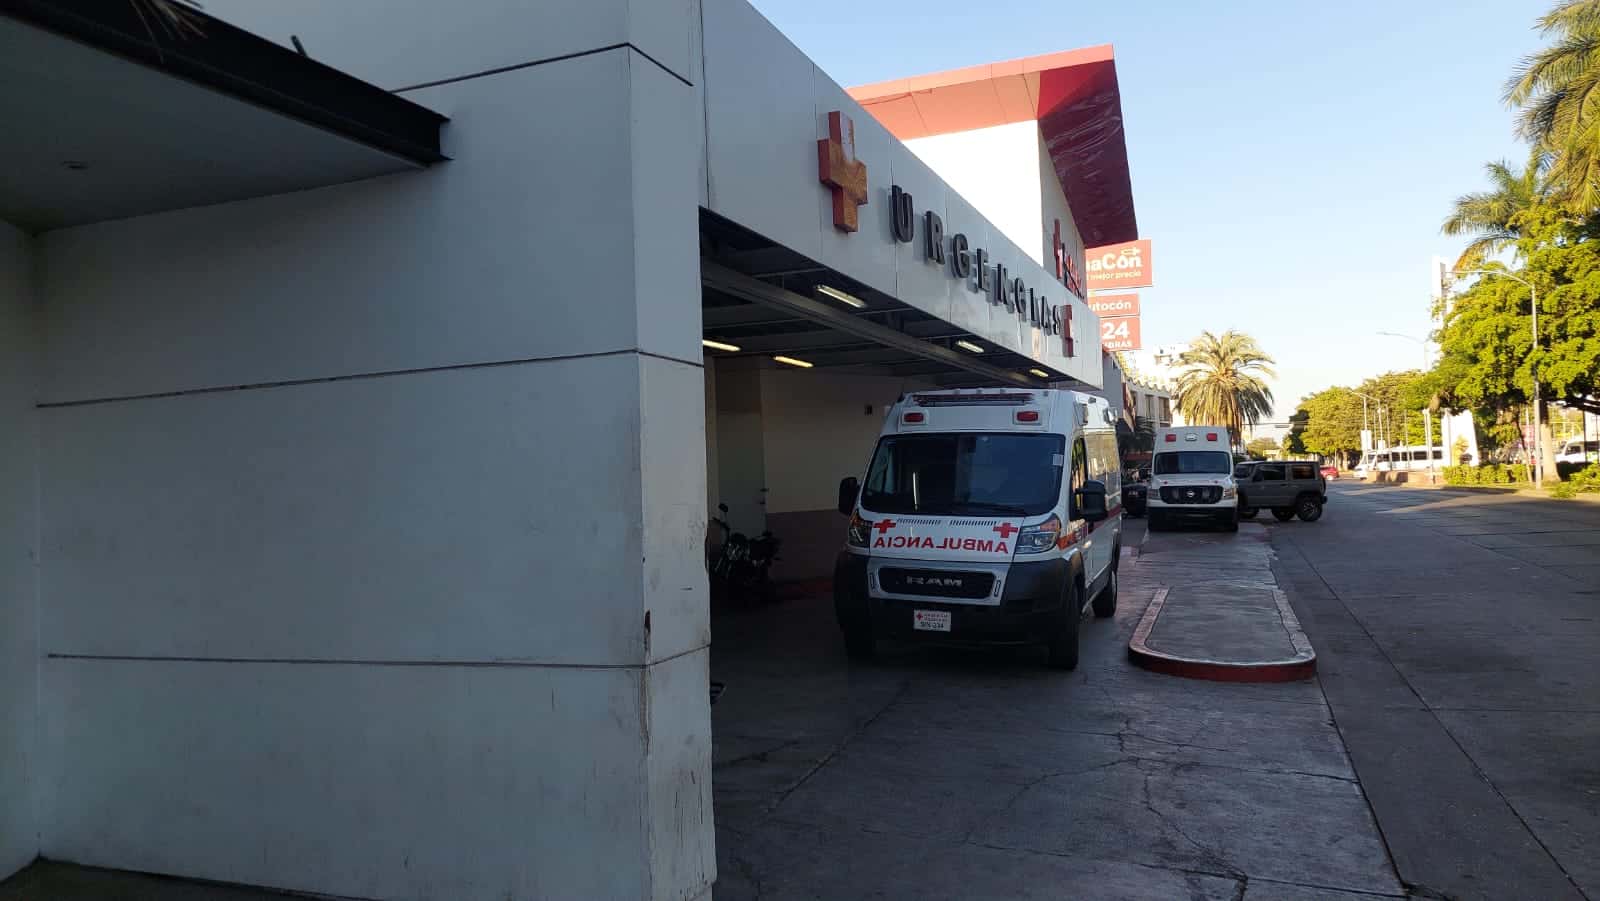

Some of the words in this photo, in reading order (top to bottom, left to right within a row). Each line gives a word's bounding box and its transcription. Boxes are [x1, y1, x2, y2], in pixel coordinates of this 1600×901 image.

[890, 184, 1061, 336] URGENCIAS
[1090, 272, 1116, 281] mejor
[1116, 271, 1142, 279] precio
[1088, 300, 1131, 311] utocón
[1102, 320, 1130, 339] 24
[906, 575, 963, 587] RAM
